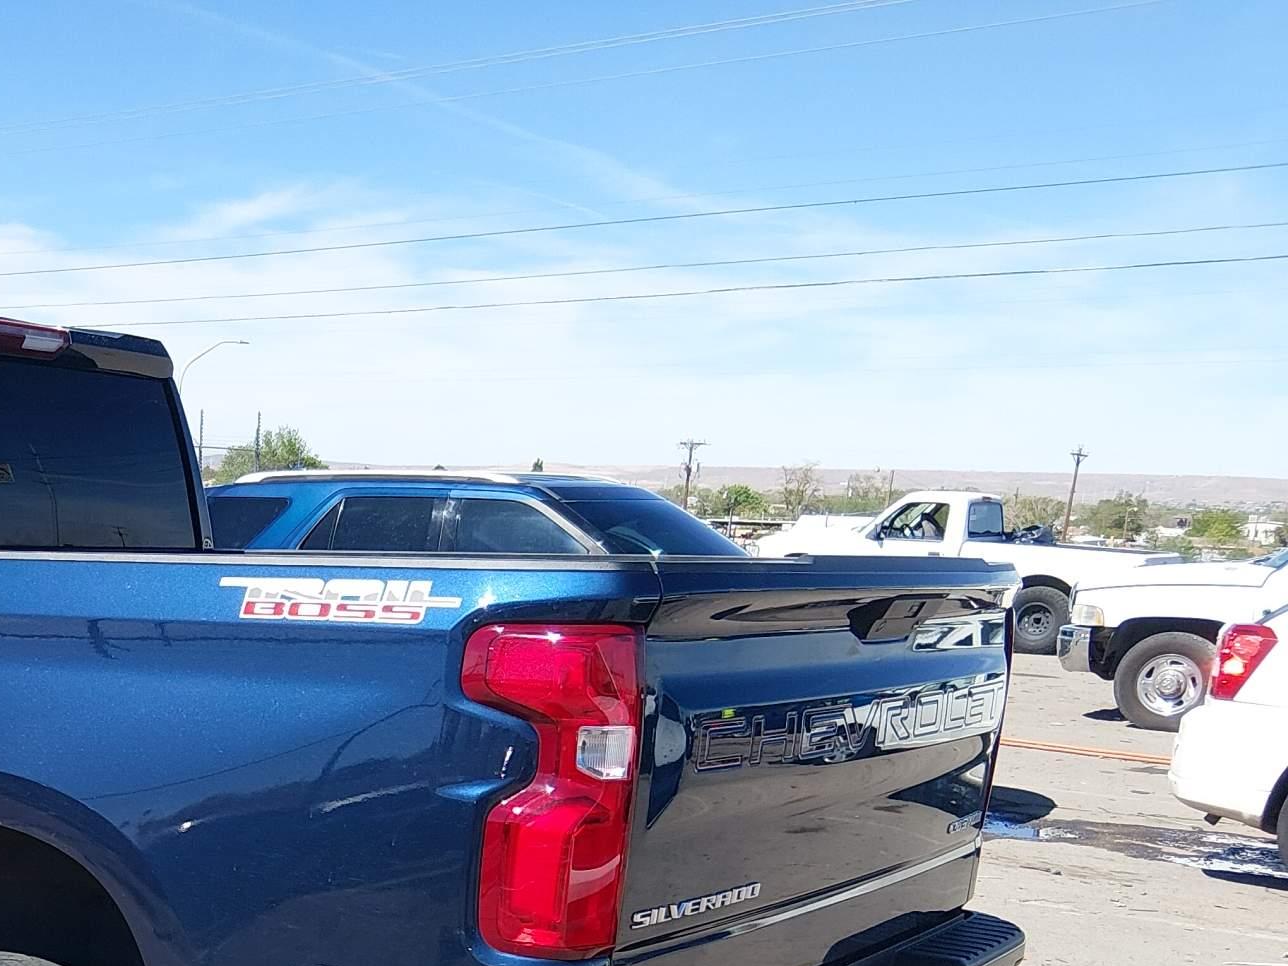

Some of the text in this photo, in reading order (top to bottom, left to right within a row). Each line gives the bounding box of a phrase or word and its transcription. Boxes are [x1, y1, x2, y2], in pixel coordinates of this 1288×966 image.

[218, 577, 461, 608] TRAIL
[239, 600, 426, 624] BOSS
[694, 681, 1005, 773] CHEVROLET
[631, 881, 762, 930] SILVERADO
